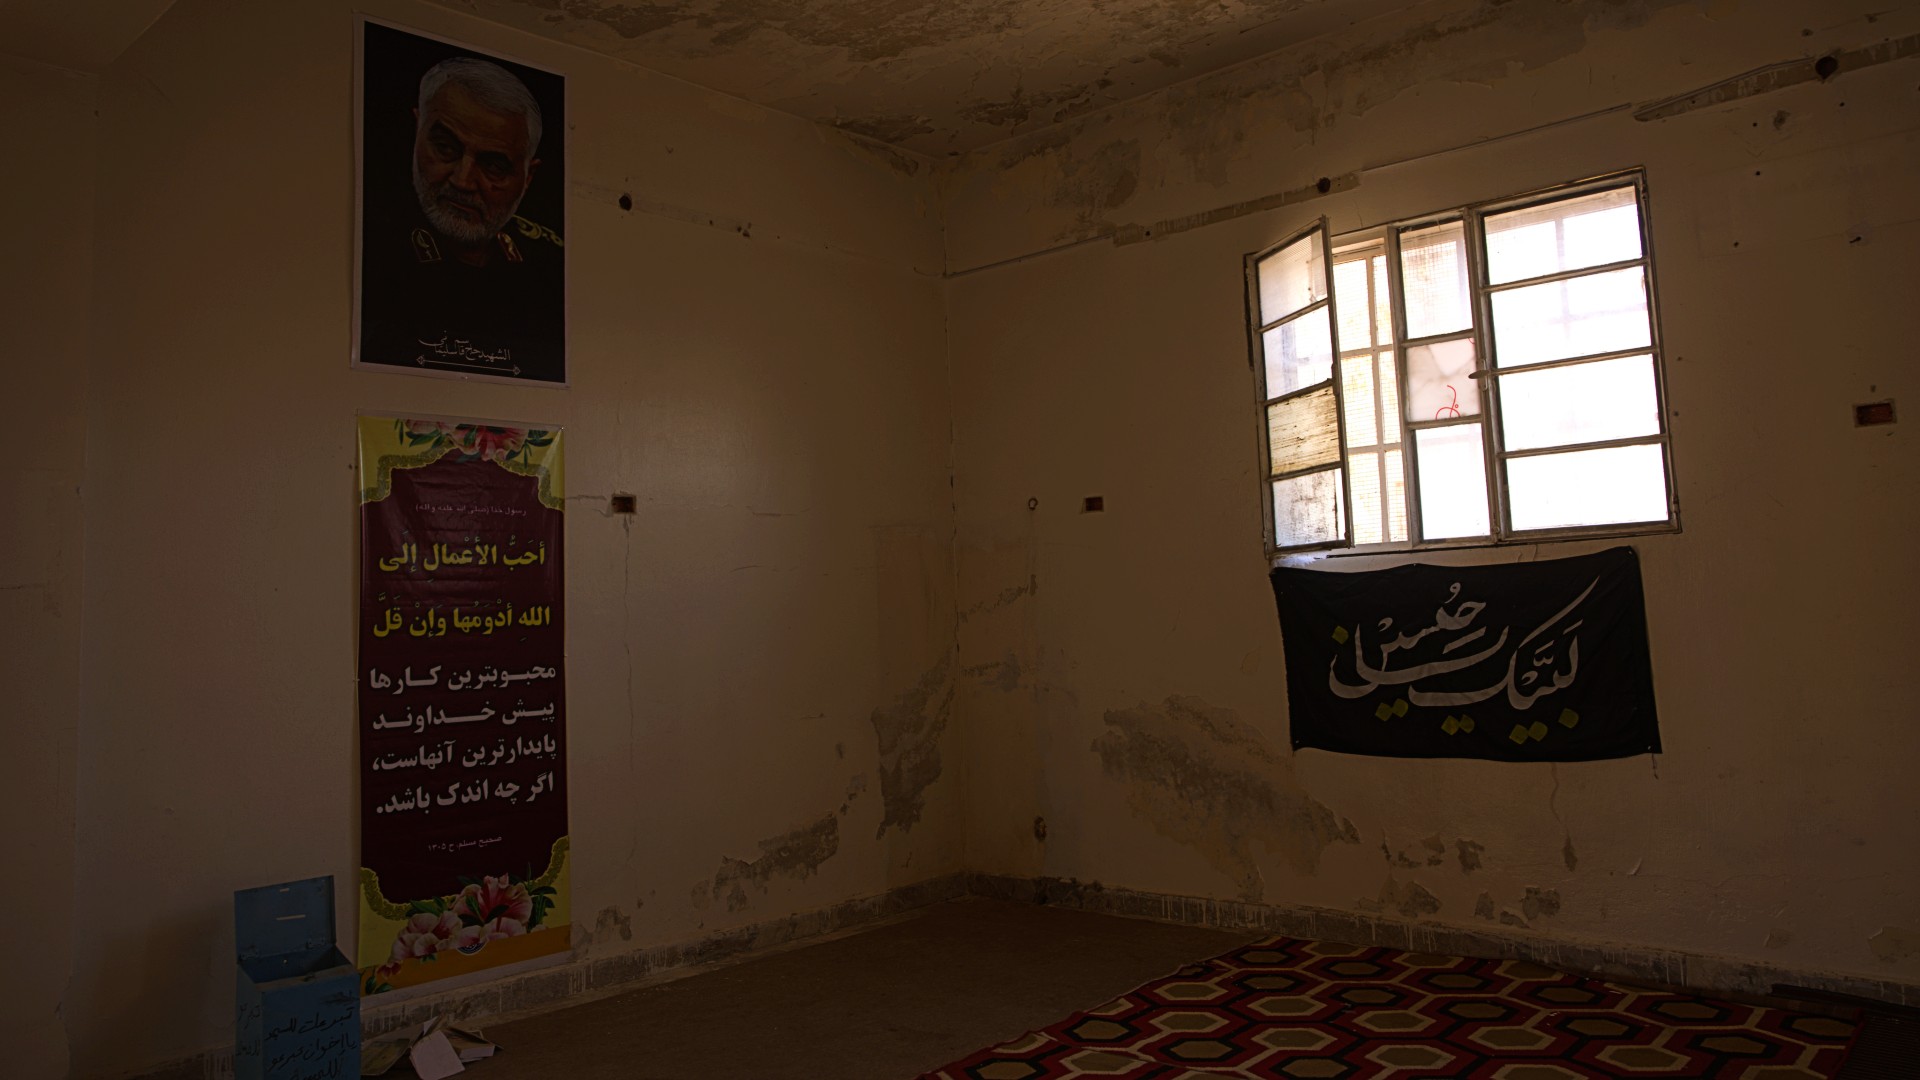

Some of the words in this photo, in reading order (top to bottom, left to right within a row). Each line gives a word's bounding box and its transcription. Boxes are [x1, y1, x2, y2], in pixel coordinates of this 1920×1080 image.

[369, 664, 442, 695] کارها
[447, 664, 557, 691] محبوبترین
[372, 699, 497, 734] خداوند
[501, 698, 556, 725] پیش
[372, 739, 457, 772] آنهاست،
[461, 732, 557, 769] پایدارترین
[375, 785, 431, 815] باشد.
[435, 777, 490, 807] اندک
[494, 780, 521, 805] چه
[525, 770, 555, 803] اگر
